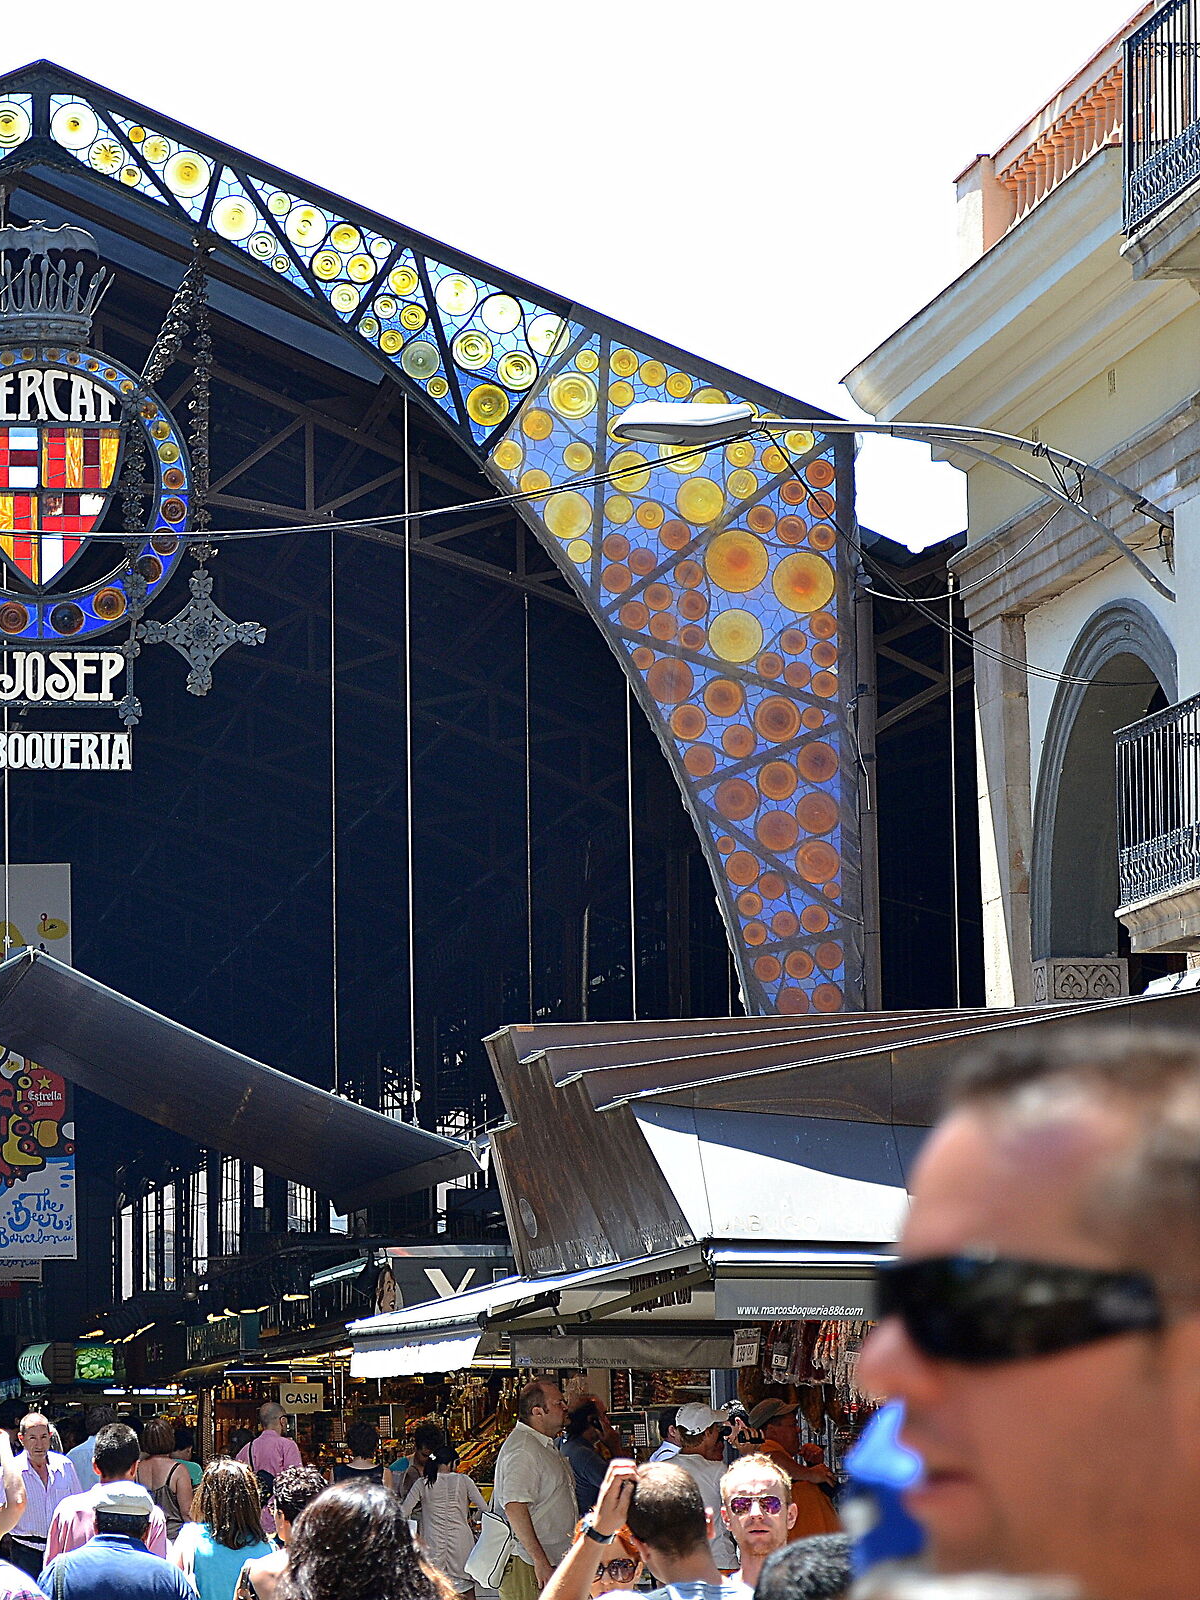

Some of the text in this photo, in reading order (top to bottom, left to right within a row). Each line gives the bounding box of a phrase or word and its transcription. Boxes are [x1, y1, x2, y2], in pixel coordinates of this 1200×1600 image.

[28, 1091, 62, 1101] Estrella
[19, 1188, 64, 1212] The
[8, 1200, 64, 1232] Beer
[285, 1393, 318, 1404] CASH
